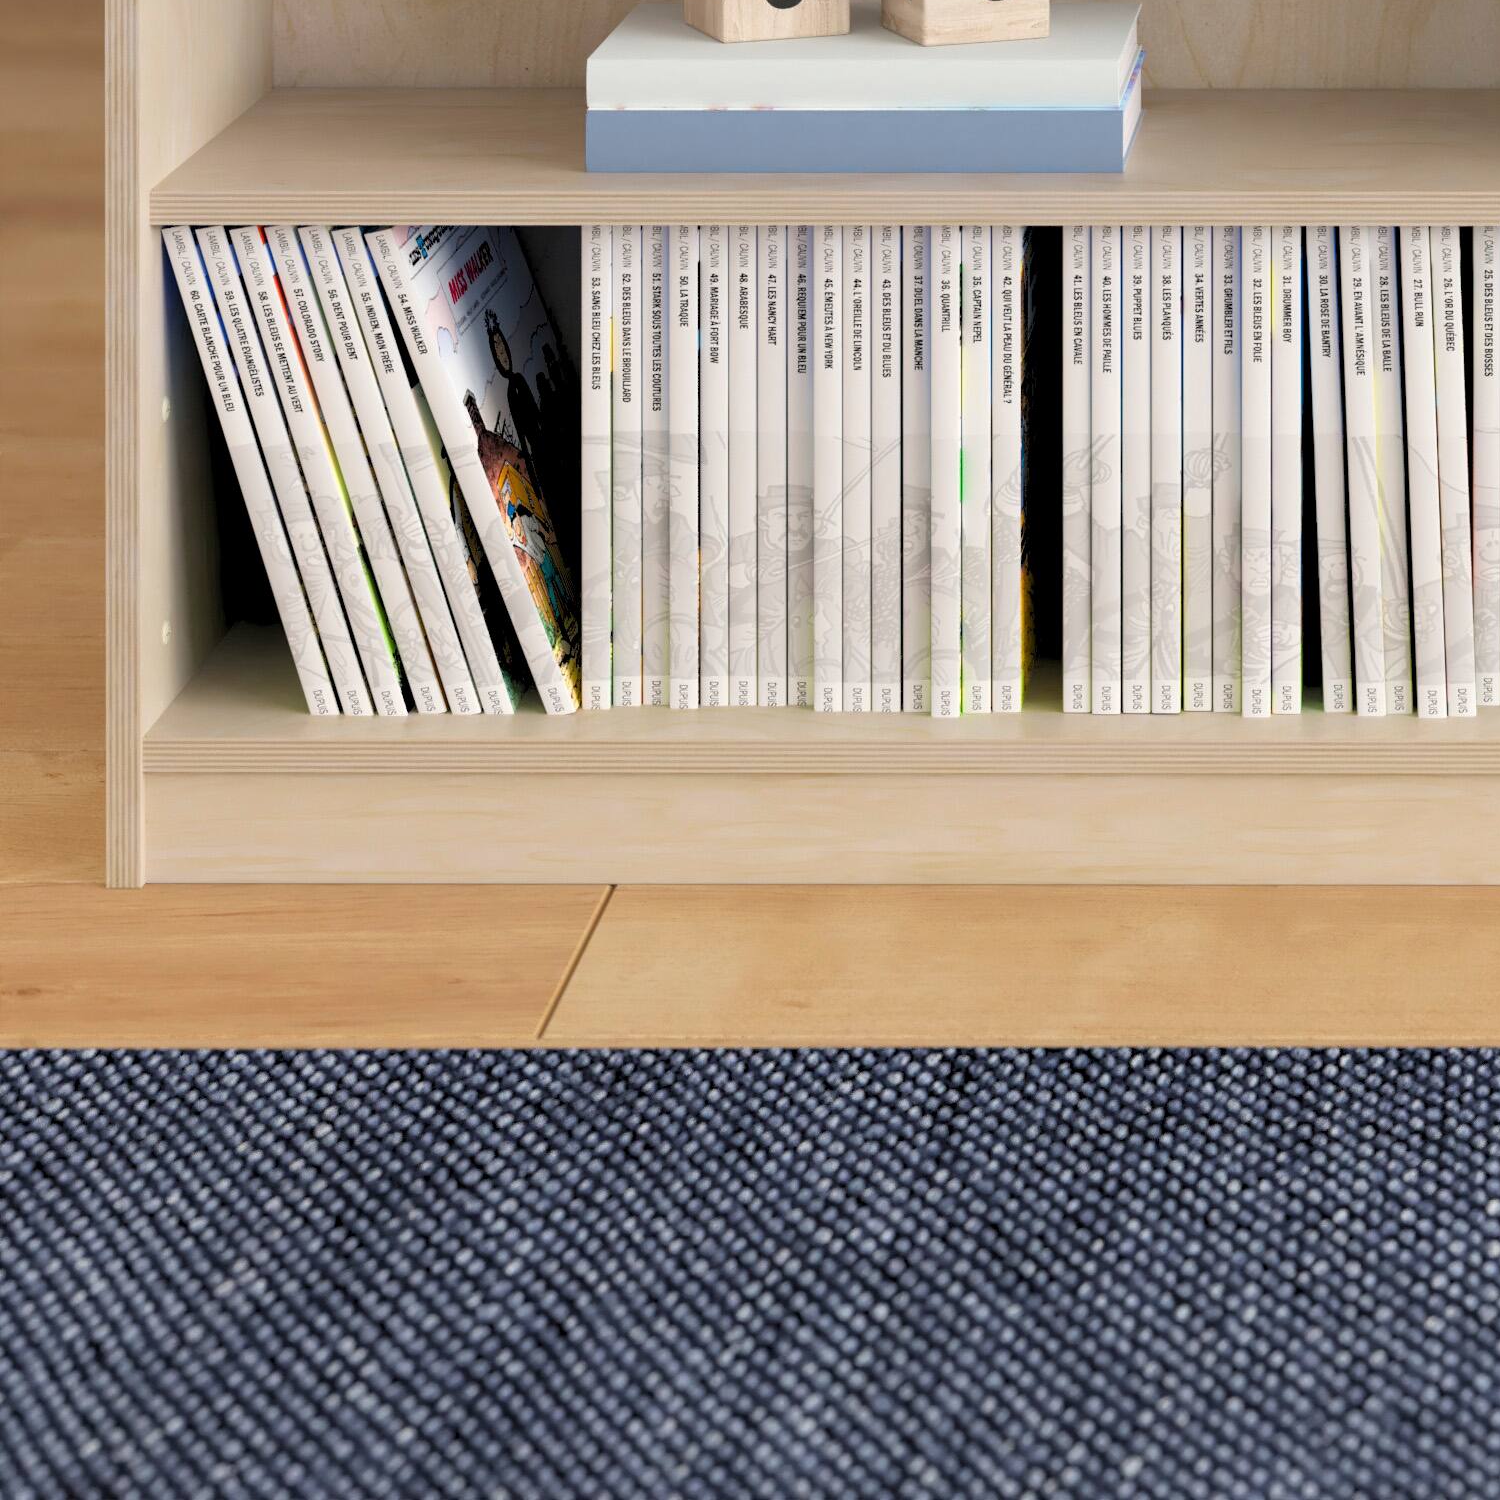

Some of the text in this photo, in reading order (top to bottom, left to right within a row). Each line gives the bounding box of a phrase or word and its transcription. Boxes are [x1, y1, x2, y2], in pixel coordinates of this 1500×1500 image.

[1003, 276, 1012, 287] 42.
[1444, 278, 1453, 290] 26.
[190, 290, 200, 302] 60.
[224, 290, 234, 302] 59.
[397, 293, 408, 305] 54.
[1002, 289, 1012, 302] QUI
[193, 303, 208, 325] CARTE
[228, 303, 239, 316] LES
[402, 306, 416, 325] MISS
[1003, 304, 1012, 321] VEUT
[1283, 276, 1292, 343] 31. DRUMMER BOY
[1445, 310, 1454, 320] DU
[231, 317, 248, 345] QUATRE
[293, 288, 324, 361] 57. COLORADO STORY
[327, 289, 357, 359] 56. DENT POUR DENT
[360, 292, 371, 304] 55.
[374, 332, 386, 349] MON
[914, 276, 923, 370] 37. DUEL DANS LA MANCHE
[1003, 323, 1012, 331] LA
[1102, 276, 1111, 373] 40. LES HOMMES DE PAILLE
[201, 326, 218, 359] BLANCHE
[410, 325, 427, 354] WALKER
[592, 277, 600, 390] 53. SANG BLEU CHEZ LES BLEUS
[1003, 333, 1012, 351] PEAU
[257, 291, 303, 412] 58. LES BLEUS SE METTENT AU VERT
[1003, 353, 1012, 364] DU
[212, 360, 225, 381] POUR
[218, 381, 228, 392] UN
[221, 393, 234, 411] BLEU
[313, 689, 328, 714] DUPUIS
[421, 686, 435, 712] DUPUIS
[548, 687, 564, 712] DUPUIS
